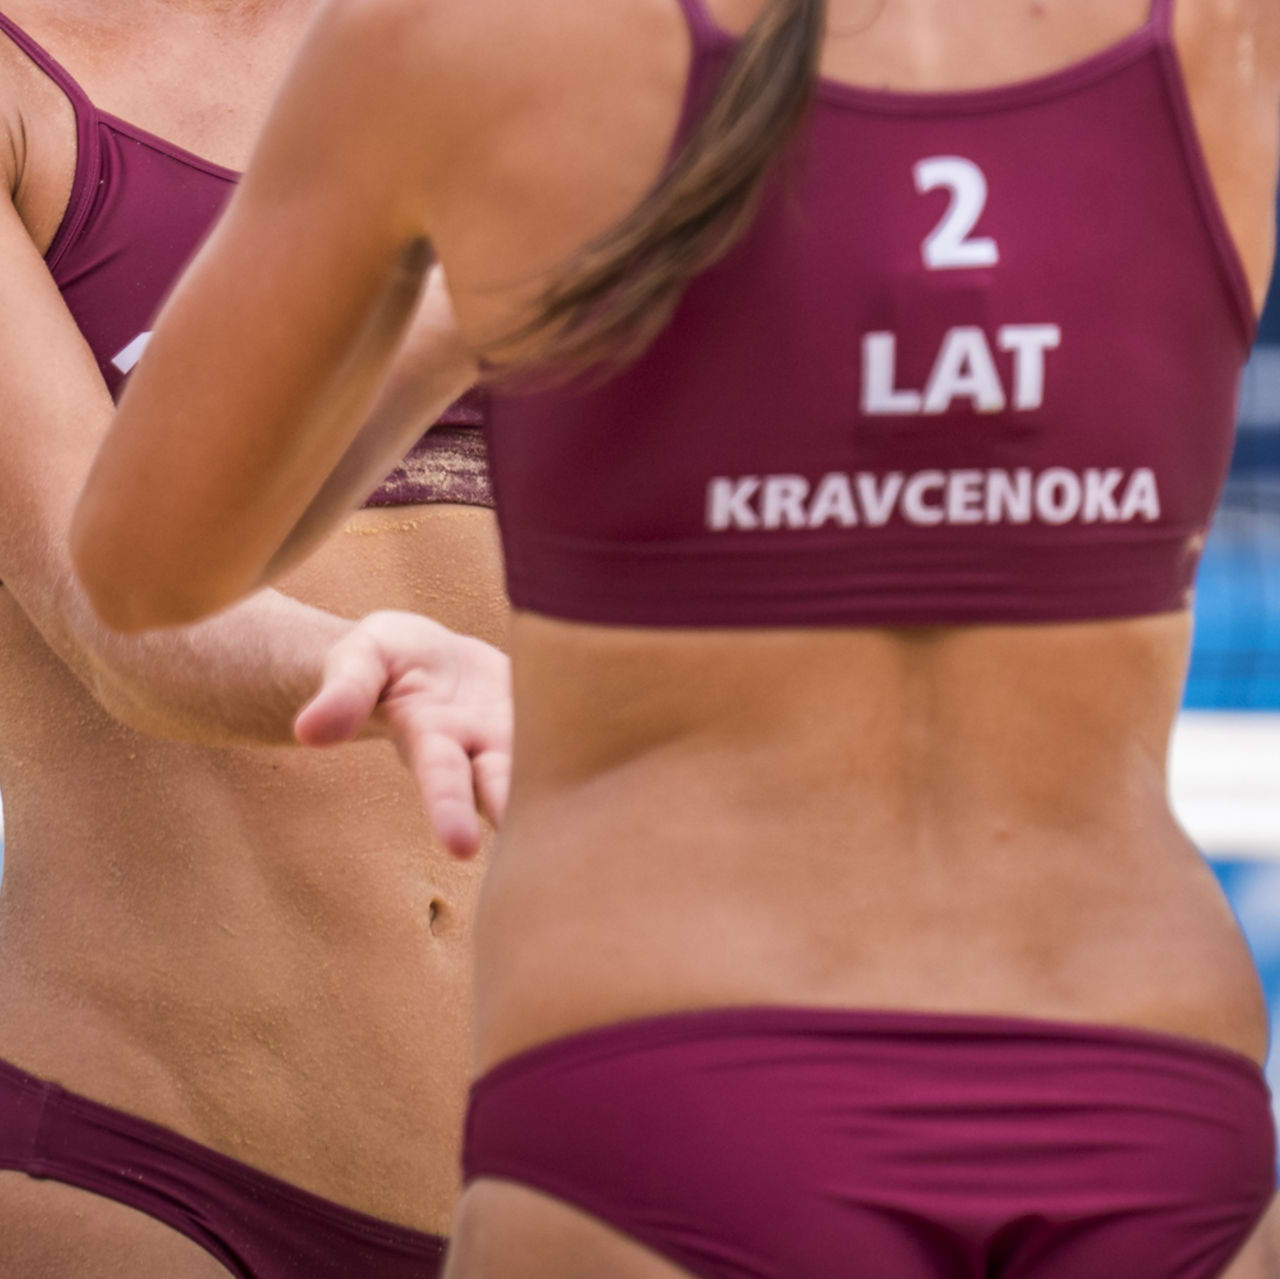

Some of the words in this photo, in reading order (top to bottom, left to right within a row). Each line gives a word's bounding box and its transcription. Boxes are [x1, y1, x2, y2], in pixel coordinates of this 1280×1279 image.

[914, 155, 1000, 270] 2
[861, 324, 1061, 415] LAT
[707, 467, 1162, 532] KRAVCENOKA
